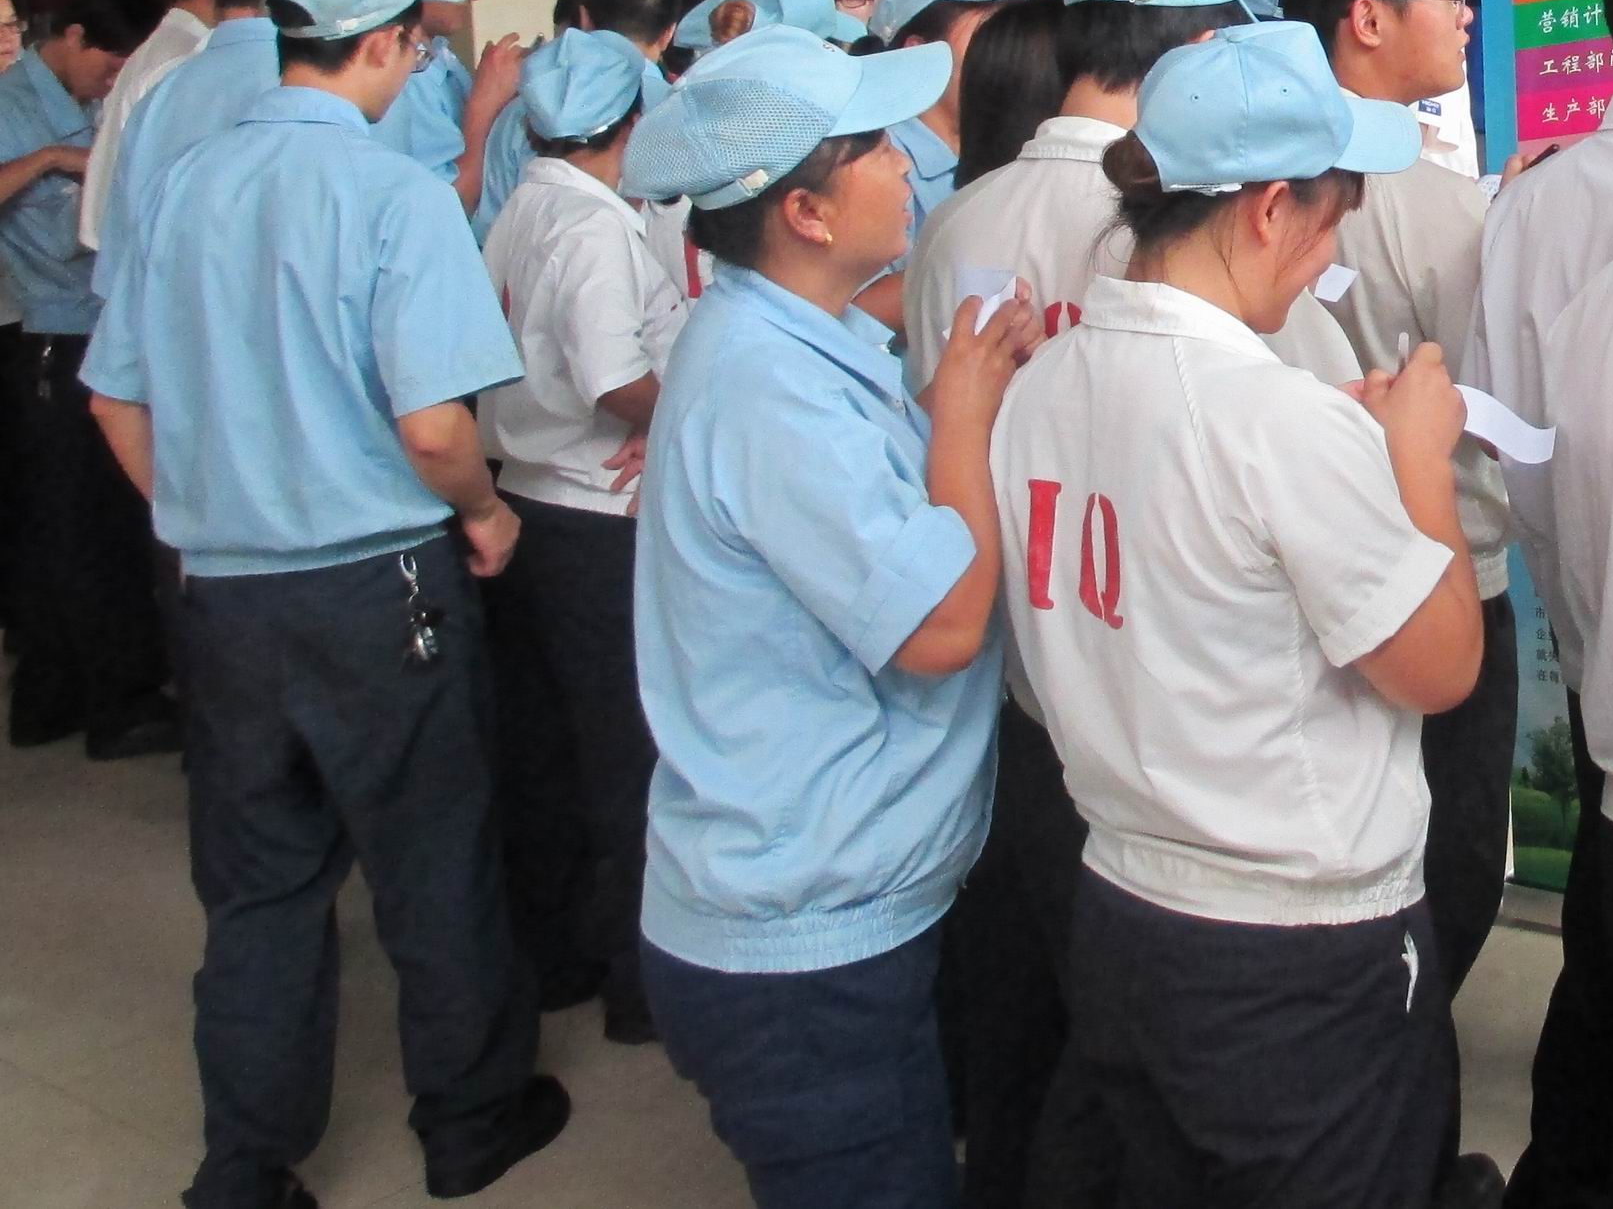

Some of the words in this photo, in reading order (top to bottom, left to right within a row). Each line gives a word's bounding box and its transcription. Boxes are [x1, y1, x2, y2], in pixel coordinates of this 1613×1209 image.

[1538, 2, 1603, 34] 营销计
[1541, 96, 1606, 124] 生产部
[1027, 478, 1124, 630] IQ
